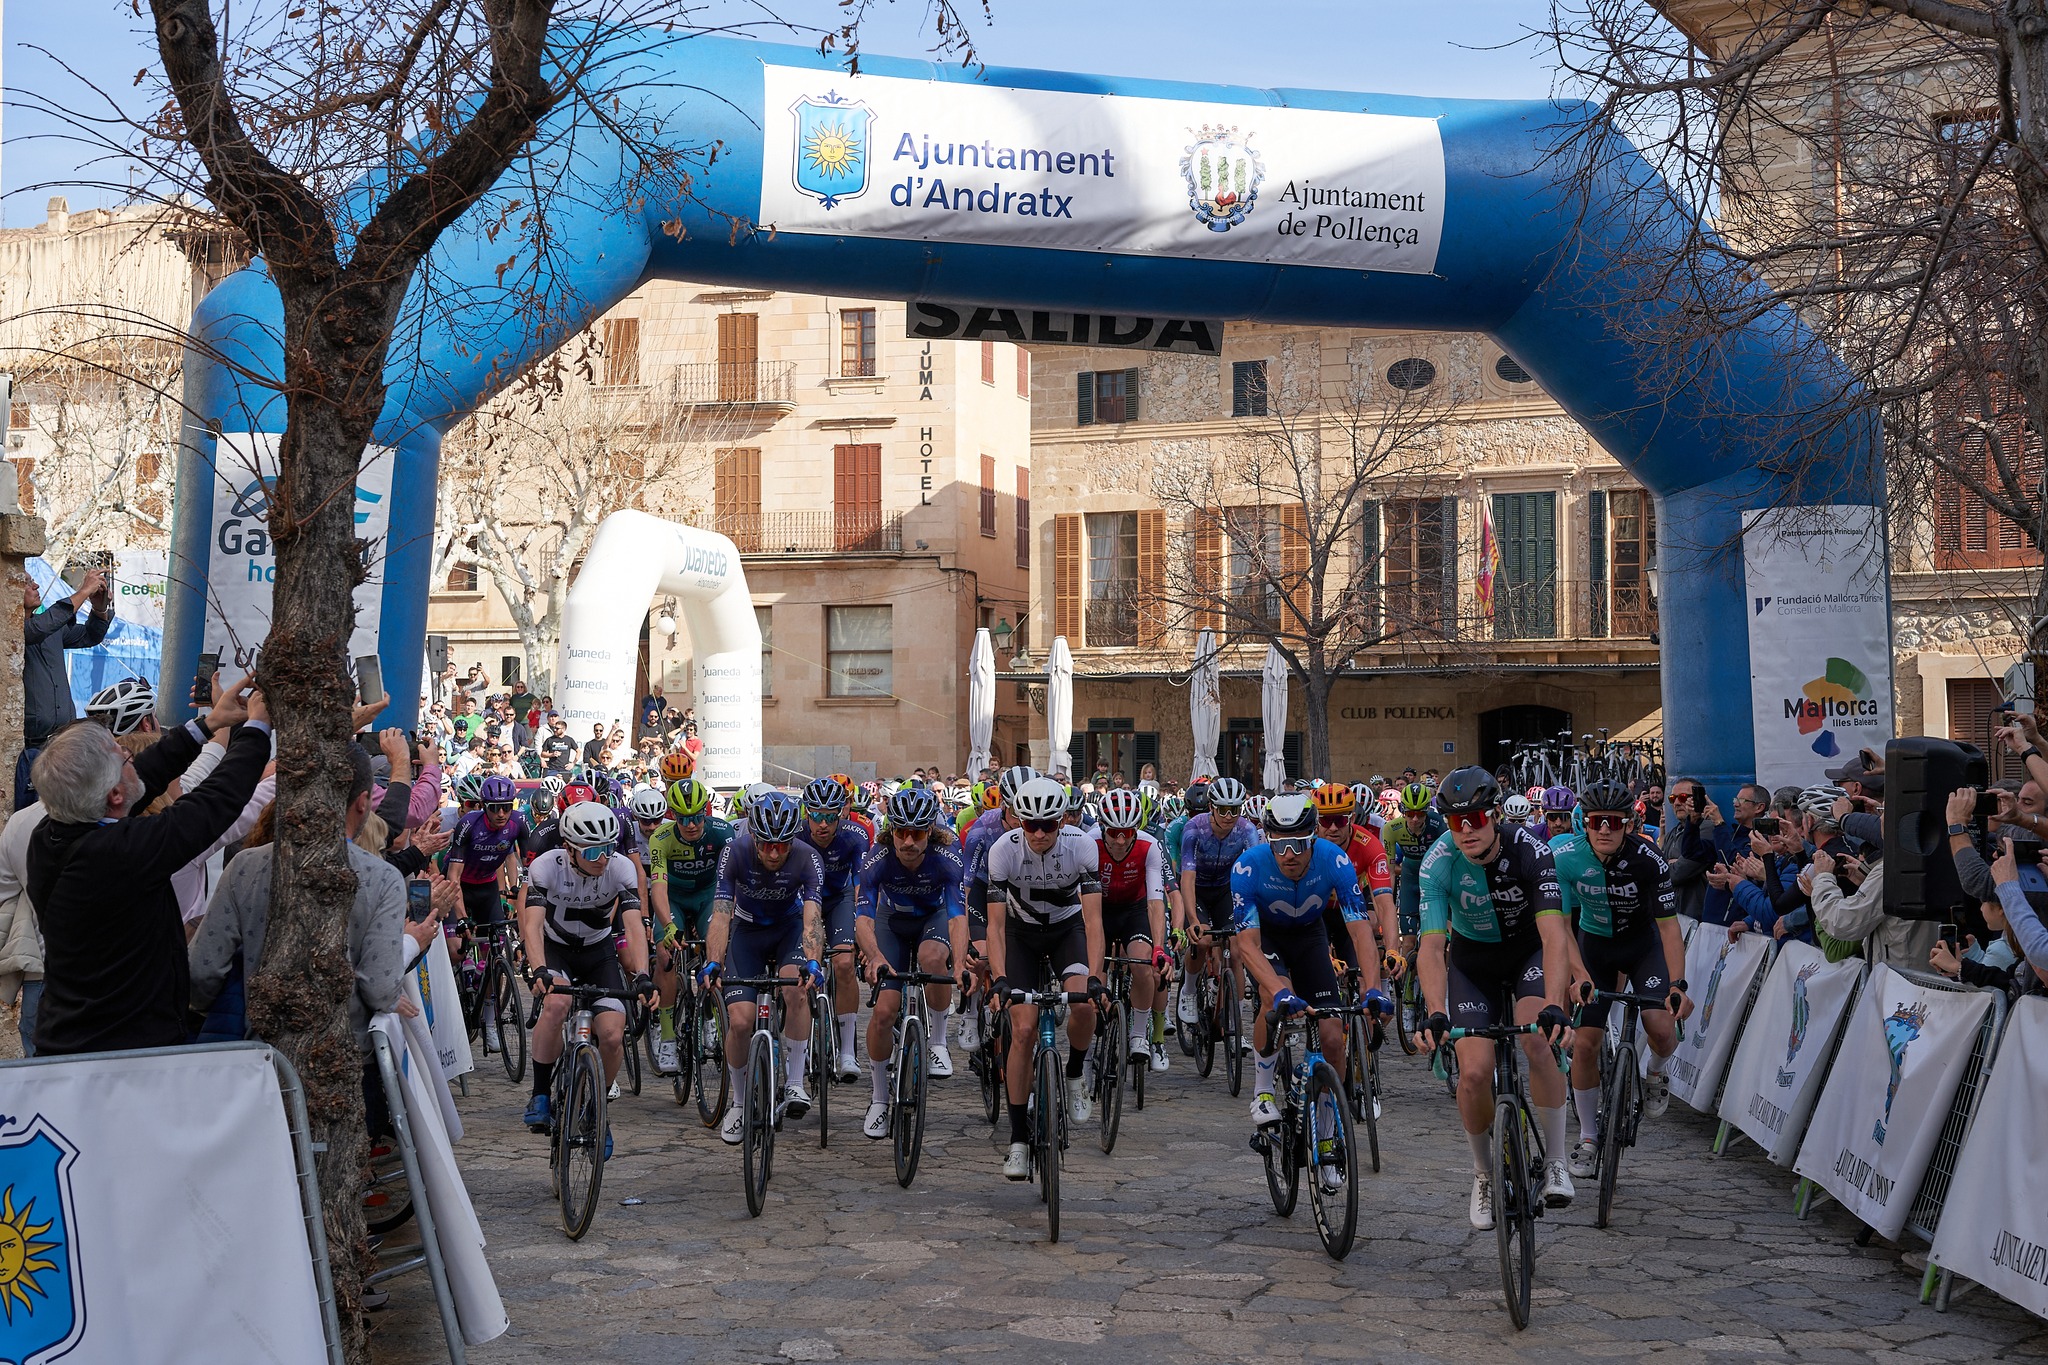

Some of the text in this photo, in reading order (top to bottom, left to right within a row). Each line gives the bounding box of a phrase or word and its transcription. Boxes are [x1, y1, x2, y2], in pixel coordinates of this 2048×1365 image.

[892, 131, 1115, 178] Ajuntament
[1278, 180, 1426, 213] Ajuntament
[1277, 212, 1420, 247] de Pollença
[913, 302, 1216, 351] SALIDA
[919, 340, 933, 401] JUMA
[920, 427, 933, 506] HOTEL
[1781, 528, 1863, 537] Patrocinadors Principals
[679, 545, 727, 577] juaneda
[1777, 594, 1821, 605] Fundació
[1824, 593, 1859, 603] Mallorca
[1777, 604, 1862, 616] Consell de Mallorca
[568, 648, 611, 660] juaneda
[704, 667, 741, 678] juaneda
[565, 679, 609, 690] juaneda
[704, 694, 741, 704] juaneda
[1341, 706, 1455, 720] CLUB POLLENÇA
[1784, 696, 1878, 719] Mallorca
[563, 709, 606, 721] juaneda
[704, 719, 741, 730] juaneda
[1832, 717, 1878, 727] Illes Balears
[704, 745, 741, 756] juaneda
[704, 770, 741, 780] juaneda
[673, 858, 715, 869] BORA
[1015, 873, 1072, 882] ARABAY
[552, 891, 609, 902] ARABAY
